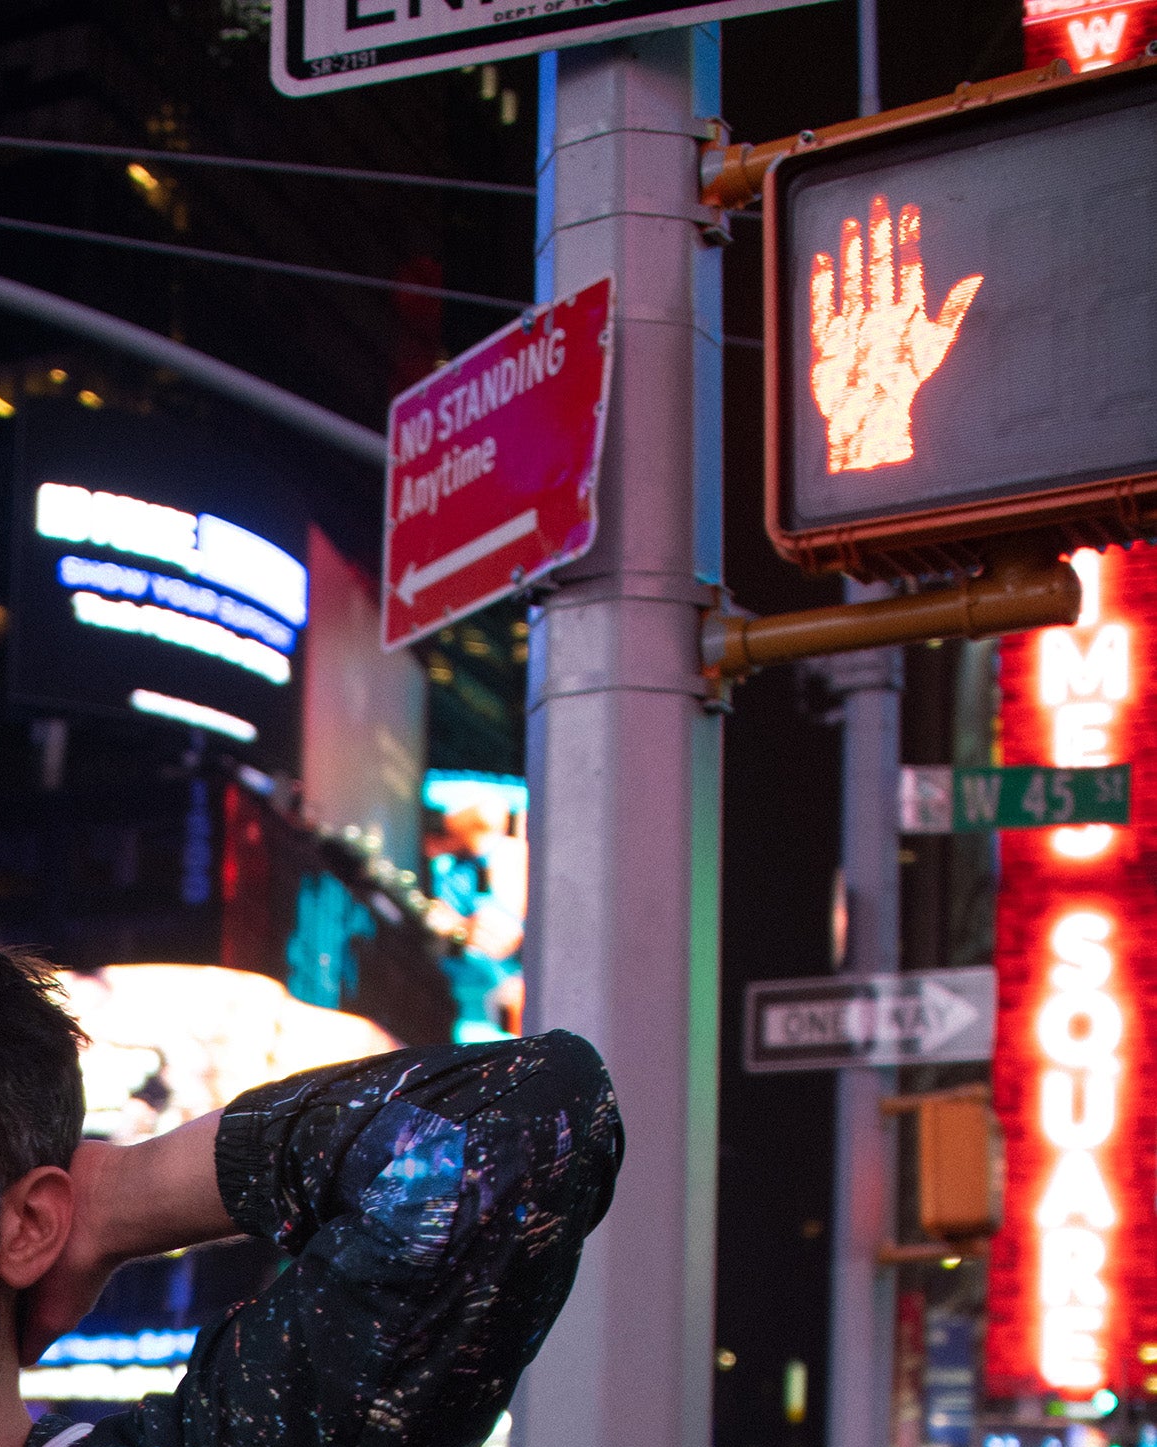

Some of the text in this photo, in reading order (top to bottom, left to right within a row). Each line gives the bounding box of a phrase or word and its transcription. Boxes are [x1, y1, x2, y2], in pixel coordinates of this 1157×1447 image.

[493, 5, 536, 22] DEPT
[398, 328, 567, 465] NO STANDING
[398, 436, 498, 523] Anytime
[962, 773, 1003, 823] W
[1022, 771, 1075, 822] 45
[1034, 911, 1124, 1388] SQUARE
